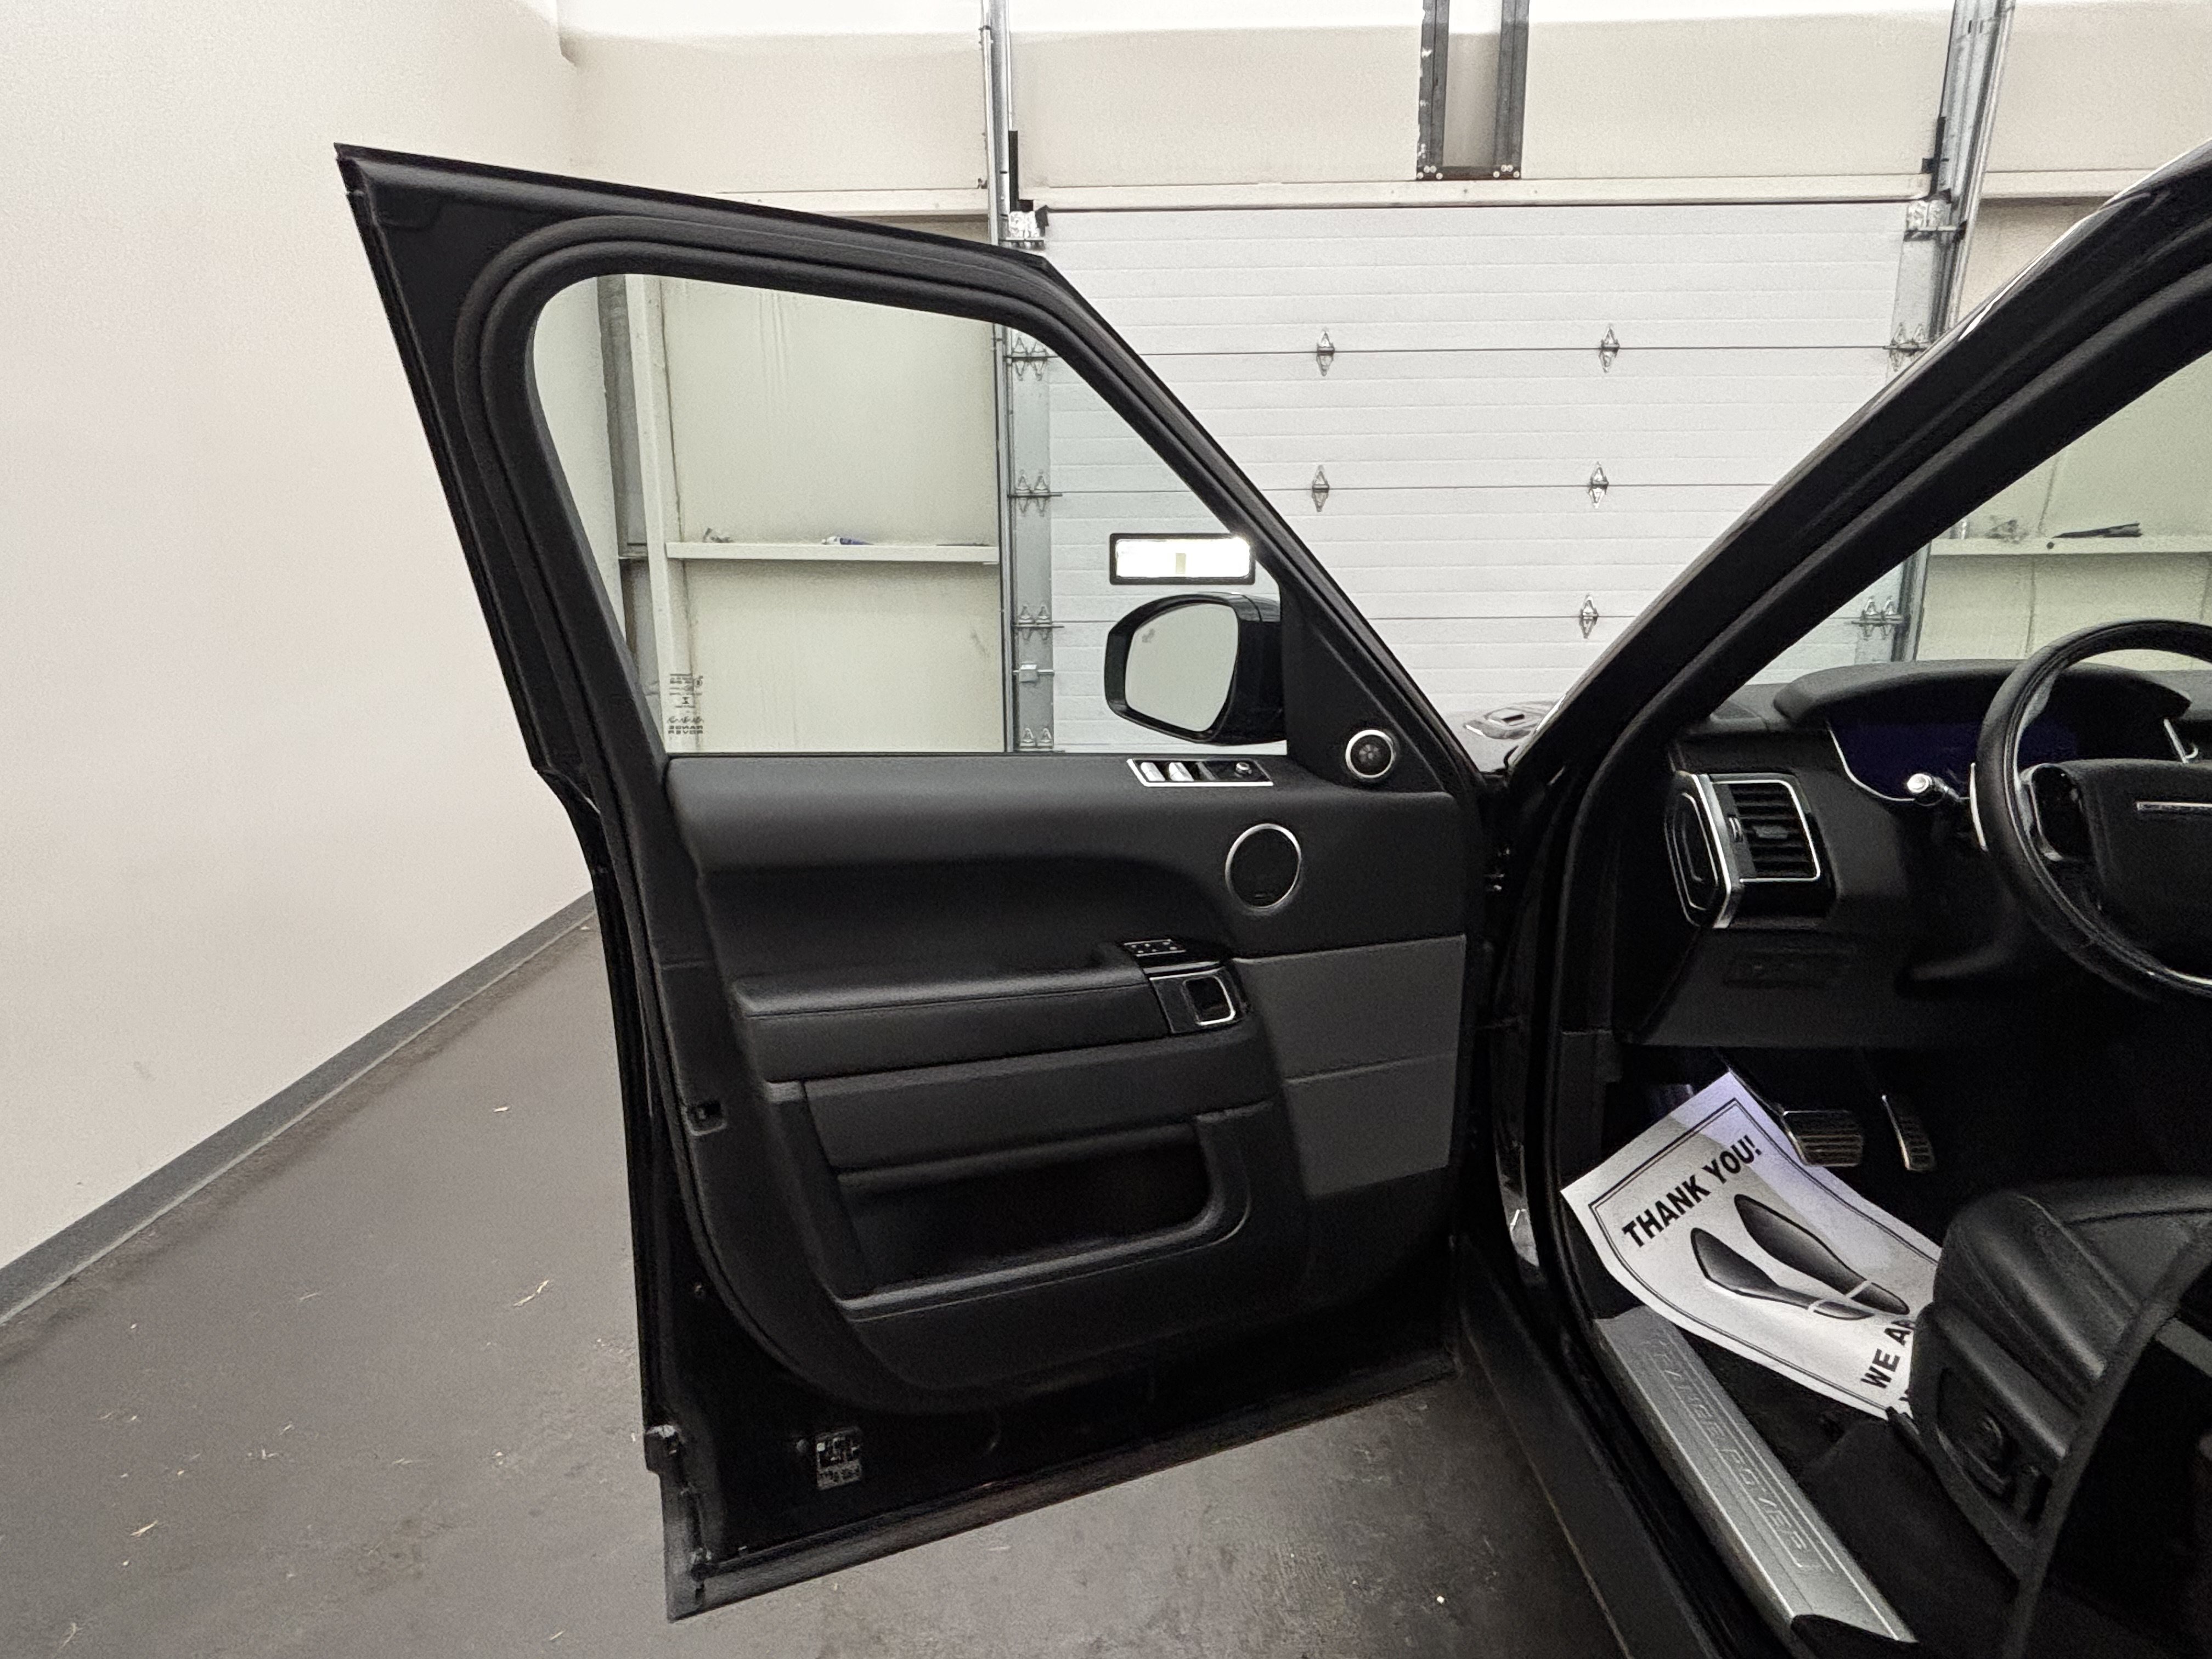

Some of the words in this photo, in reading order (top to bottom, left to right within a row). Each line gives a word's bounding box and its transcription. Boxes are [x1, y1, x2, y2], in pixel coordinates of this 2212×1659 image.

[1622, 1174, 1711, 1248] THANK
[1702, 1135, 1762, 1184] YOU!
[1860, 1348, 1900, 1389] WE
